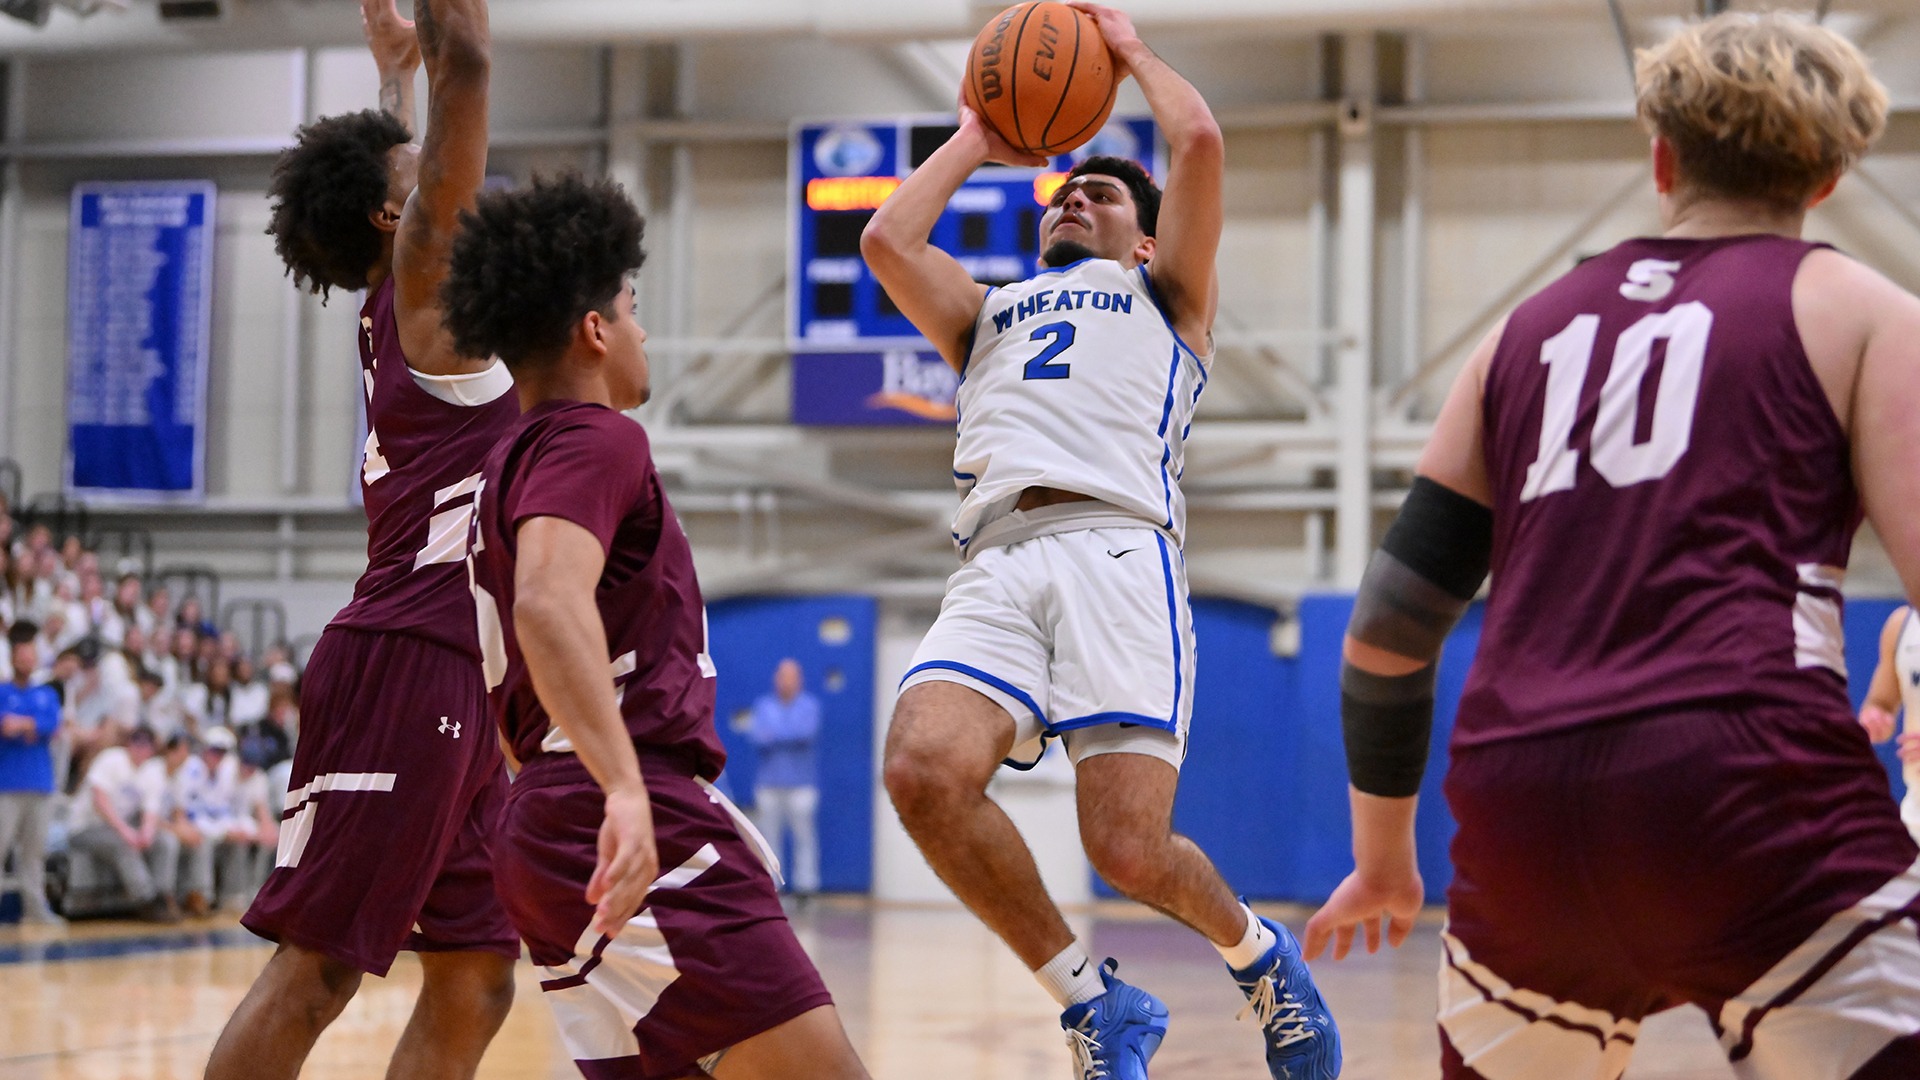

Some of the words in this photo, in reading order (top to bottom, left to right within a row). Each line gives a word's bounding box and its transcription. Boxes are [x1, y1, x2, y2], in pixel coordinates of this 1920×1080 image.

[1619, 259, 1682, 302] S
[992, 290, 1132, 334] WHEATON
[1023, 320, 1076, 381] 2
[1520, 300, 1714, 503] 10
